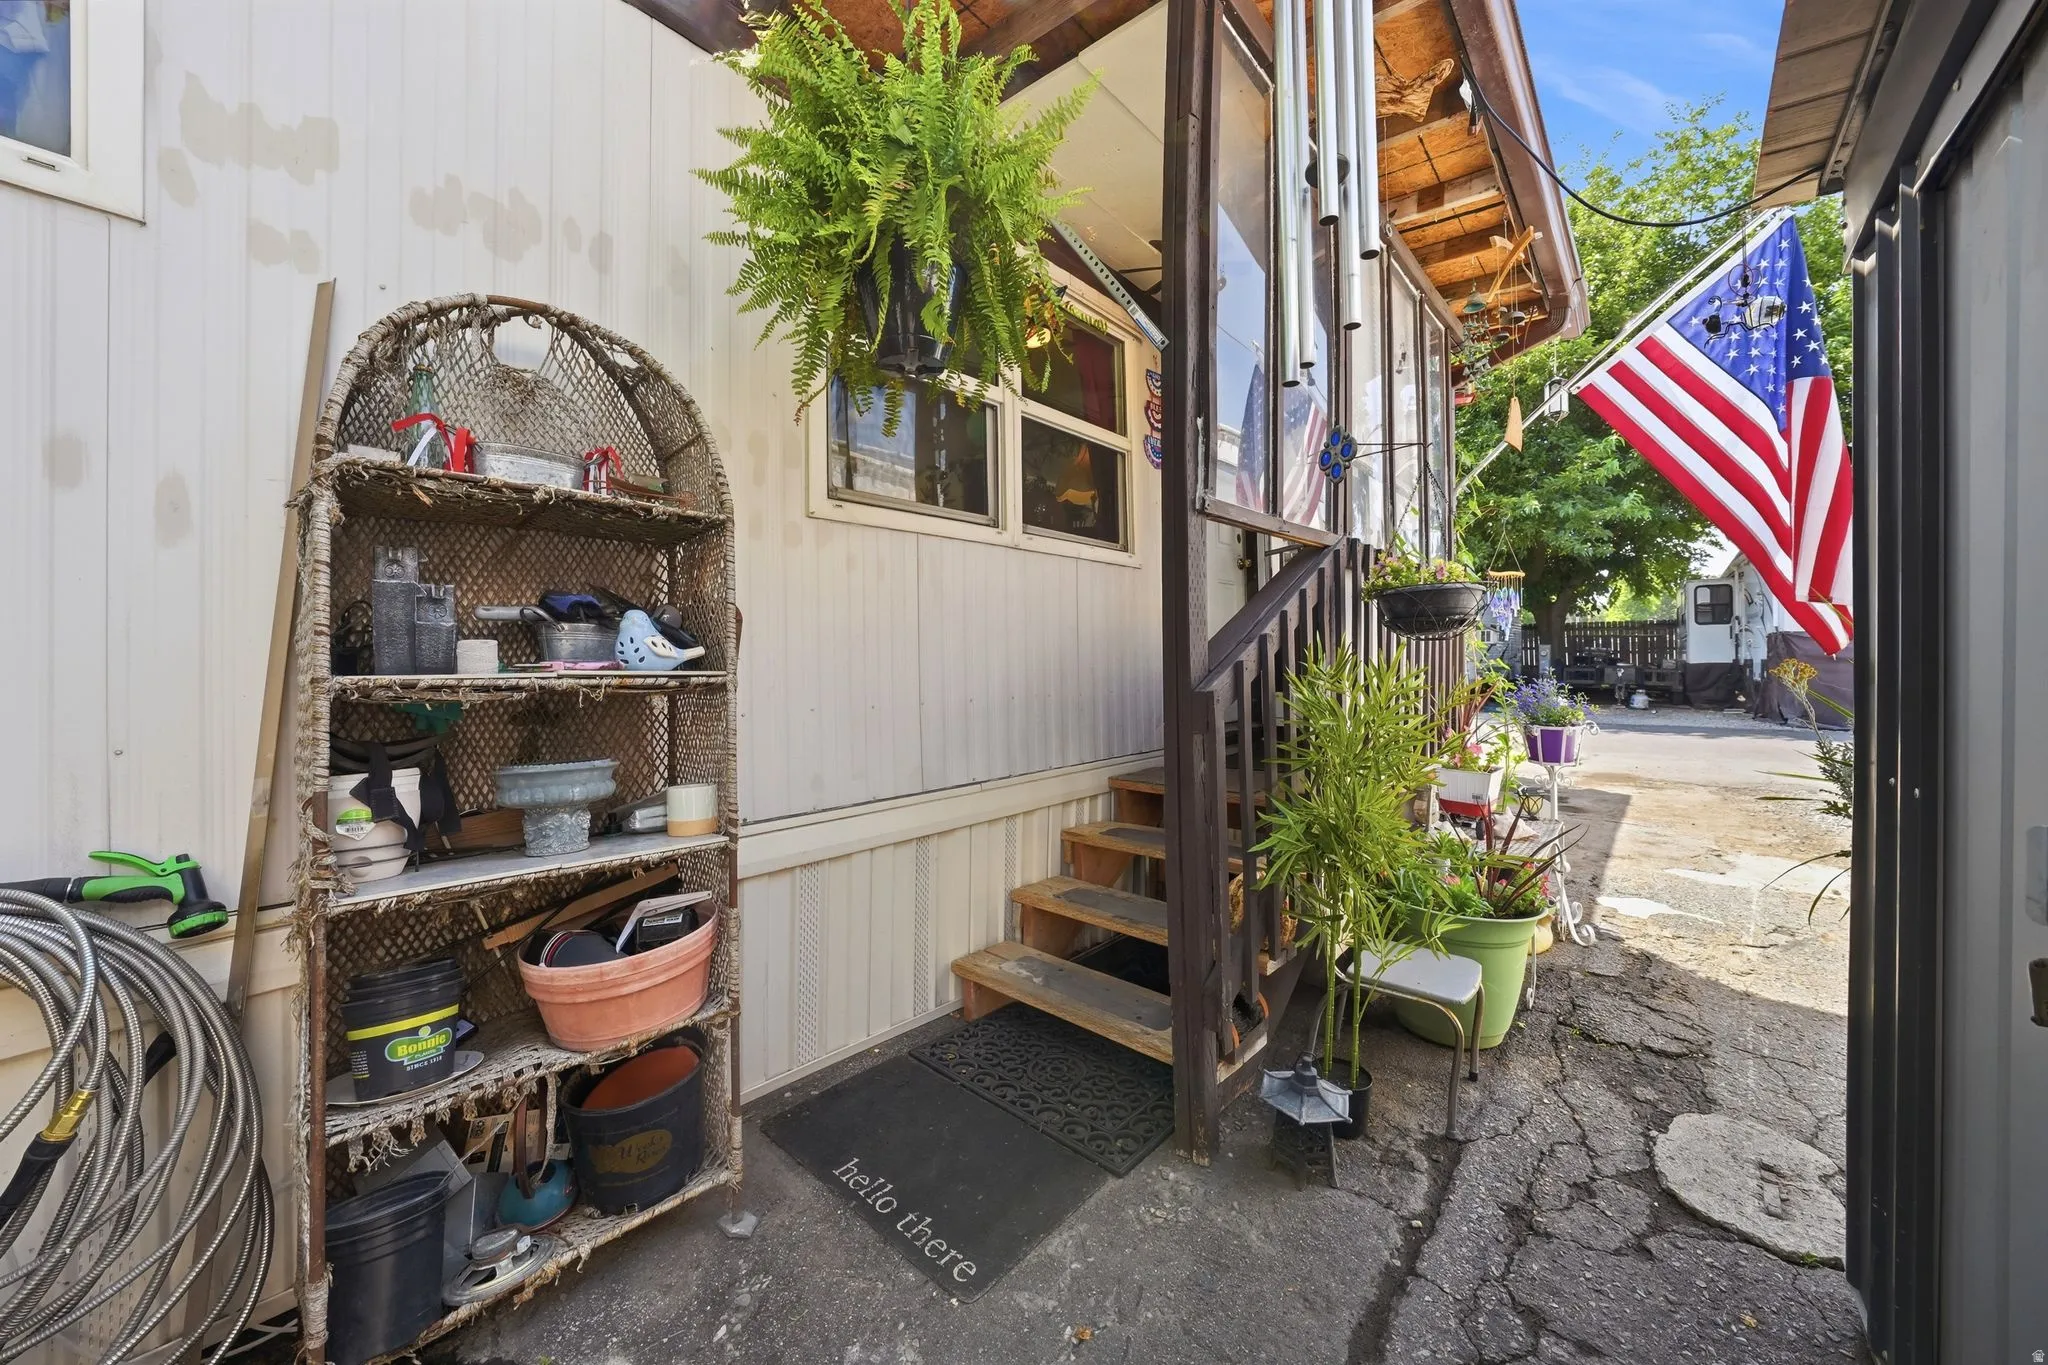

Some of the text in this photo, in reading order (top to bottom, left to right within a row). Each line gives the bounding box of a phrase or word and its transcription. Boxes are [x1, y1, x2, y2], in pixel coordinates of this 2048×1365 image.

[397, 1033, 446, 1057] Bonnie
[406, 1060, 429, 1072] SINCE
[832, 1157, 977, 1282] hello there
